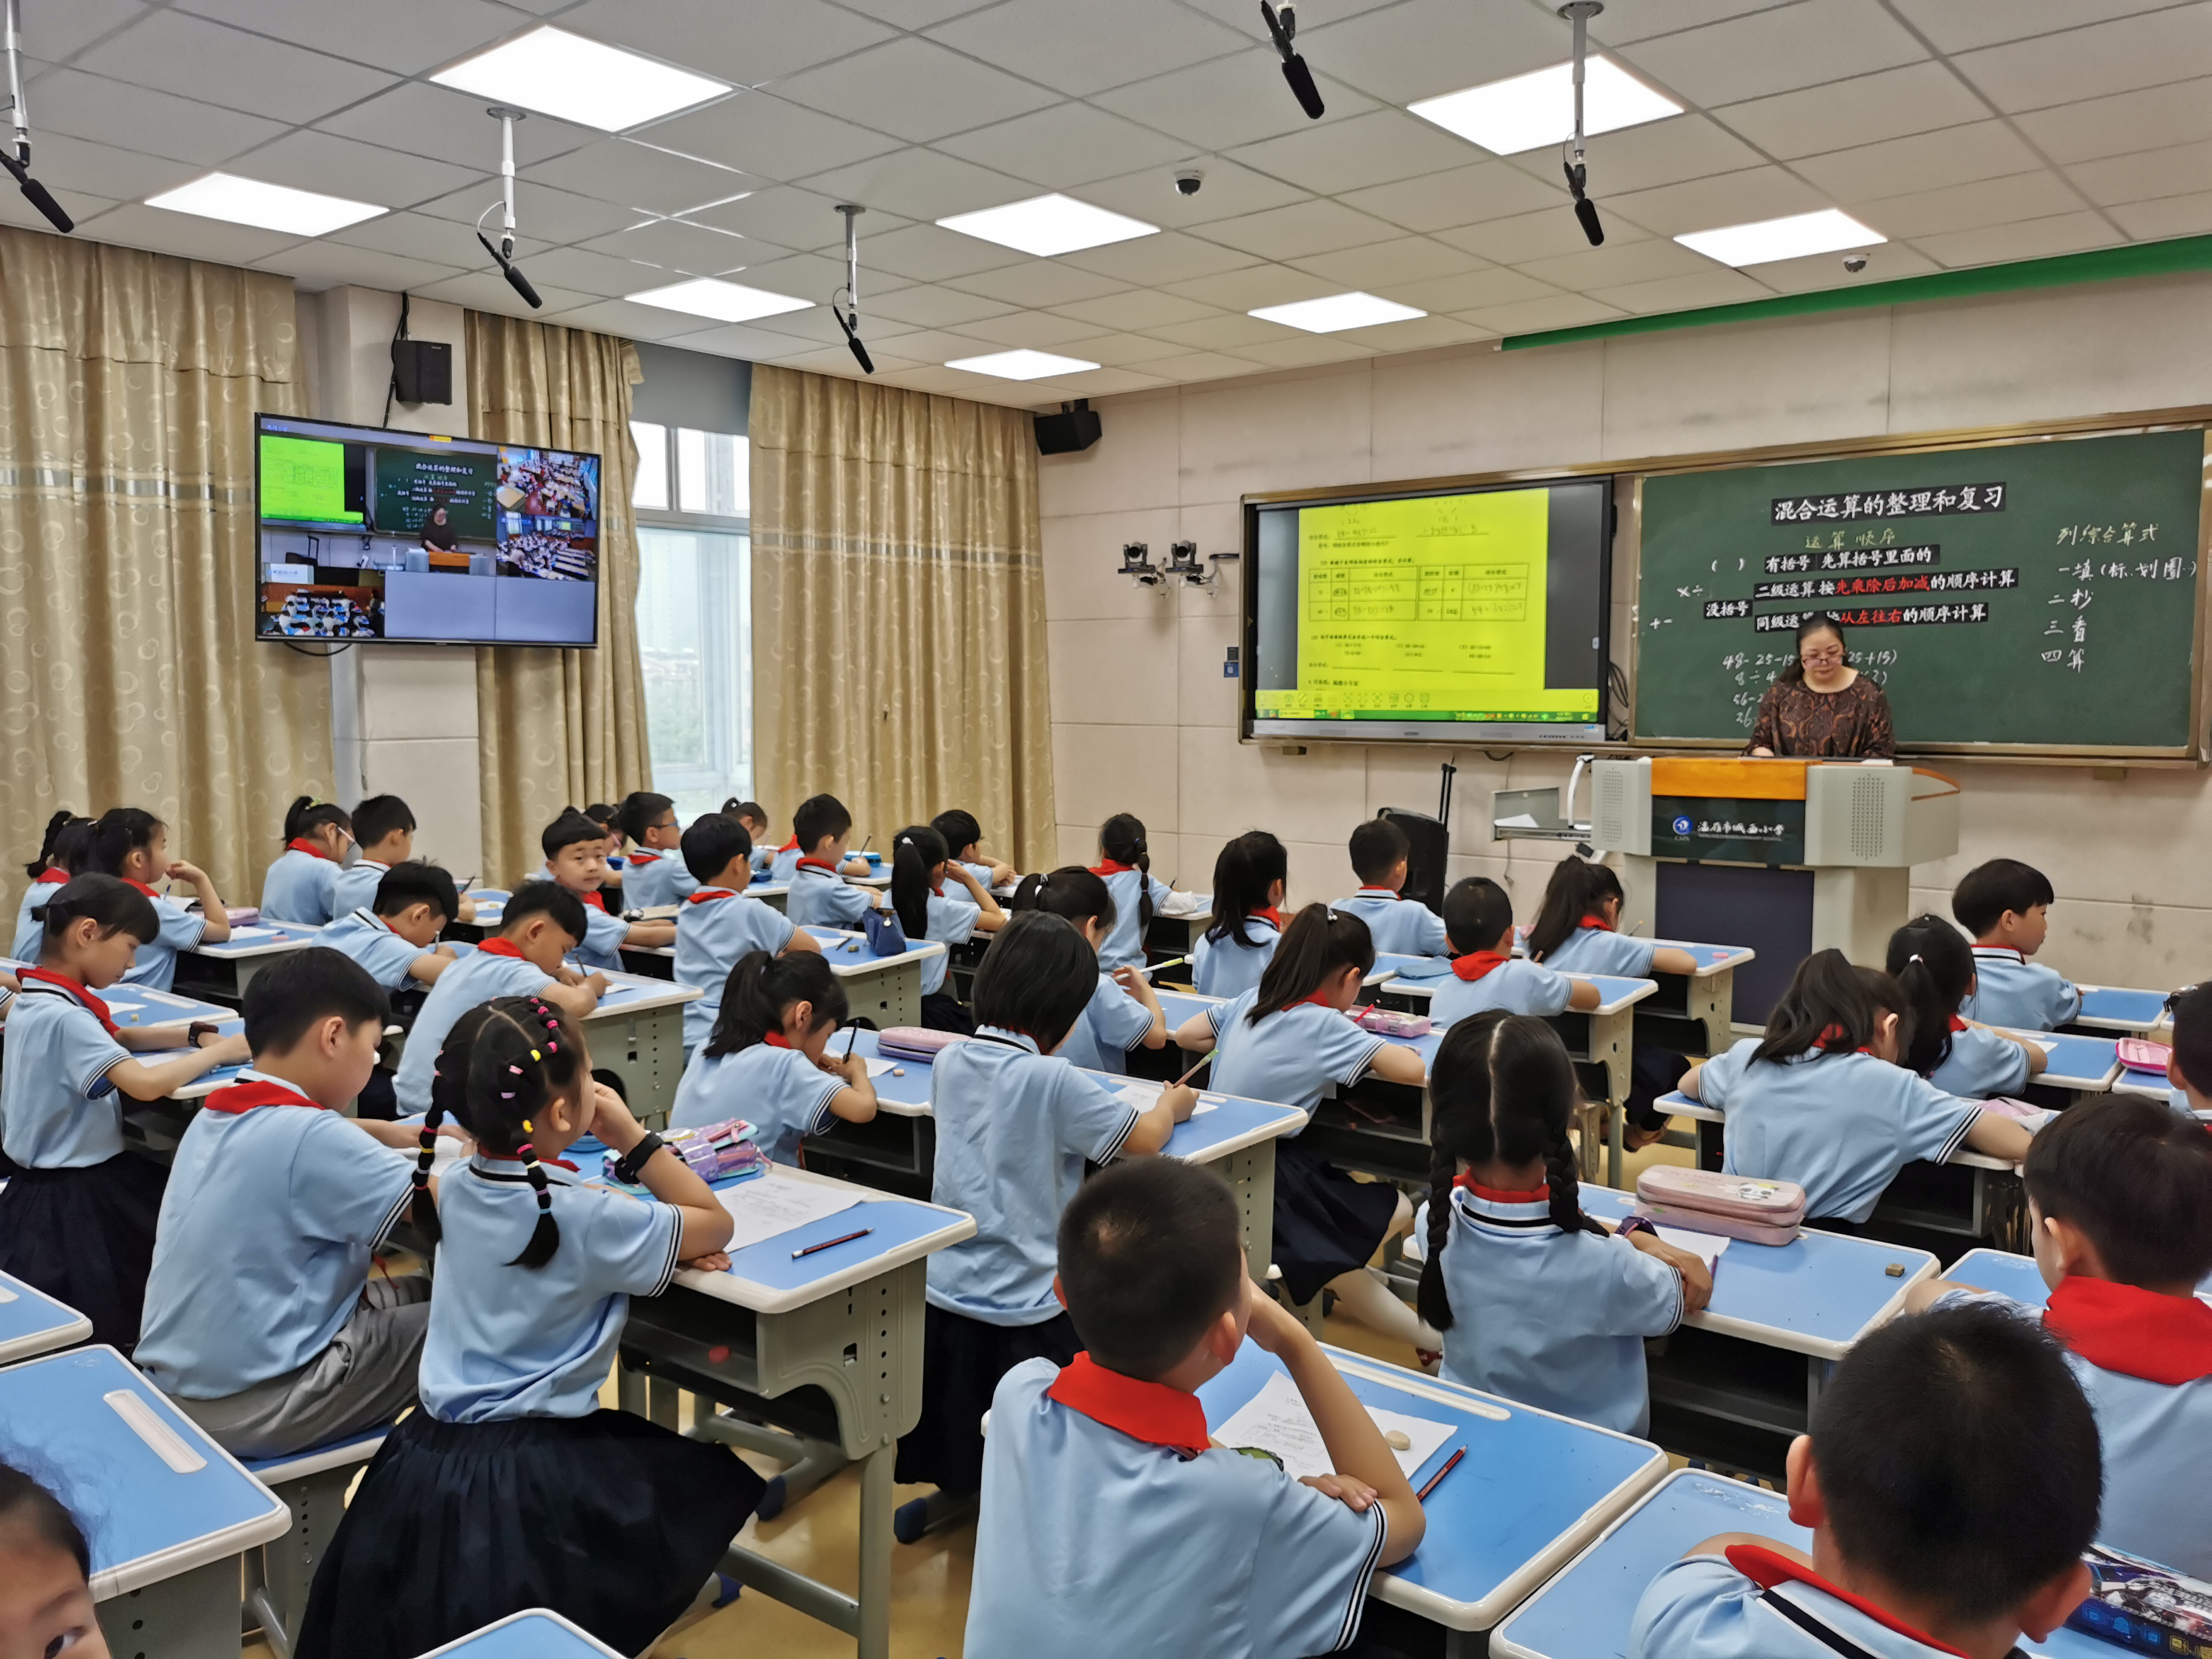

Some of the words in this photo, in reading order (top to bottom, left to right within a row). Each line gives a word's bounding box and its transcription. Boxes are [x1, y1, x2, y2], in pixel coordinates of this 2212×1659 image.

[1775, 486, 2003, 522] 混合运算的整理和复习
[1805, 527, 1895, 550] 运算顺序
[2056, 521, 2159, 546] 列综合算式
[1766, 554, 1811, 573] 有括号
[1821, 546, 1932, 570] 先算括号里面的
[1706, 600, 1749, 617] 没括号
[1756, 603, 1986, 631] 同级运从左往右的顺序计算
[2042, 648, 2085, 673] 四算
